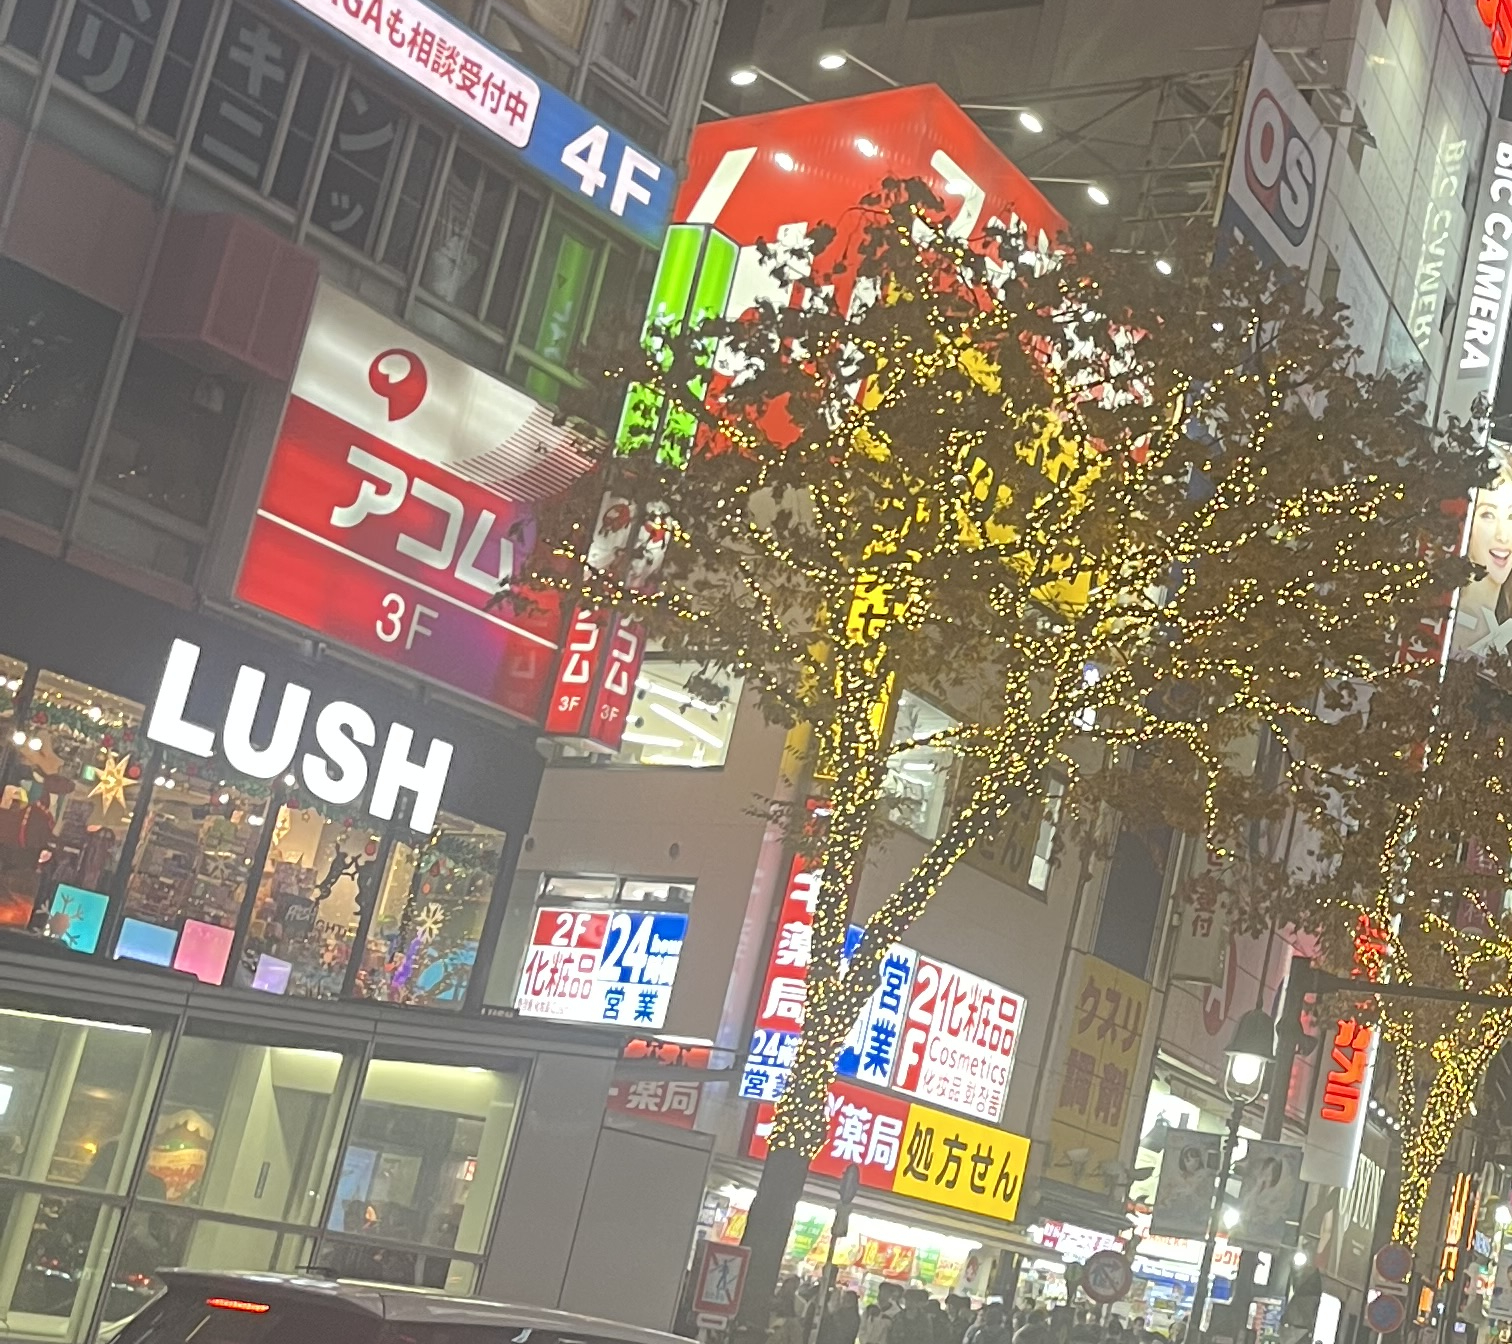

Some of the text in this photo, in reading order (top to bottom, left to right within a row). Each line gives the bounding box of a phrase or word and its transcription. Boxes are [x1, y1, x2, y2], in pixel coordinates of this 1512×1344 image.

[560, 124, 661, 217] 4F
[329, 444, 513, 595] アコム
[374, 592, 439, 651] 3F
[145, 636, 455, 835] LUSH
[558, 695, 581, 712] 3F
[600, 704, 620, 722] 3F
[551, 912, 592, 948] 2F
[599, 913, 655, 983] 24
[525, 950, 596, 1000] 化粧品
[602, 986, 659, 1023] 営業
[863, 952, 911, 1079] 営業
[939, 973, 1019, 1057] 化粧品
[1077, 974, 1143, 1053] クスリ
[928, 1035, 1007, 1087] Cosmetics
[902, 1120, 1019, 1205] 処方せん
